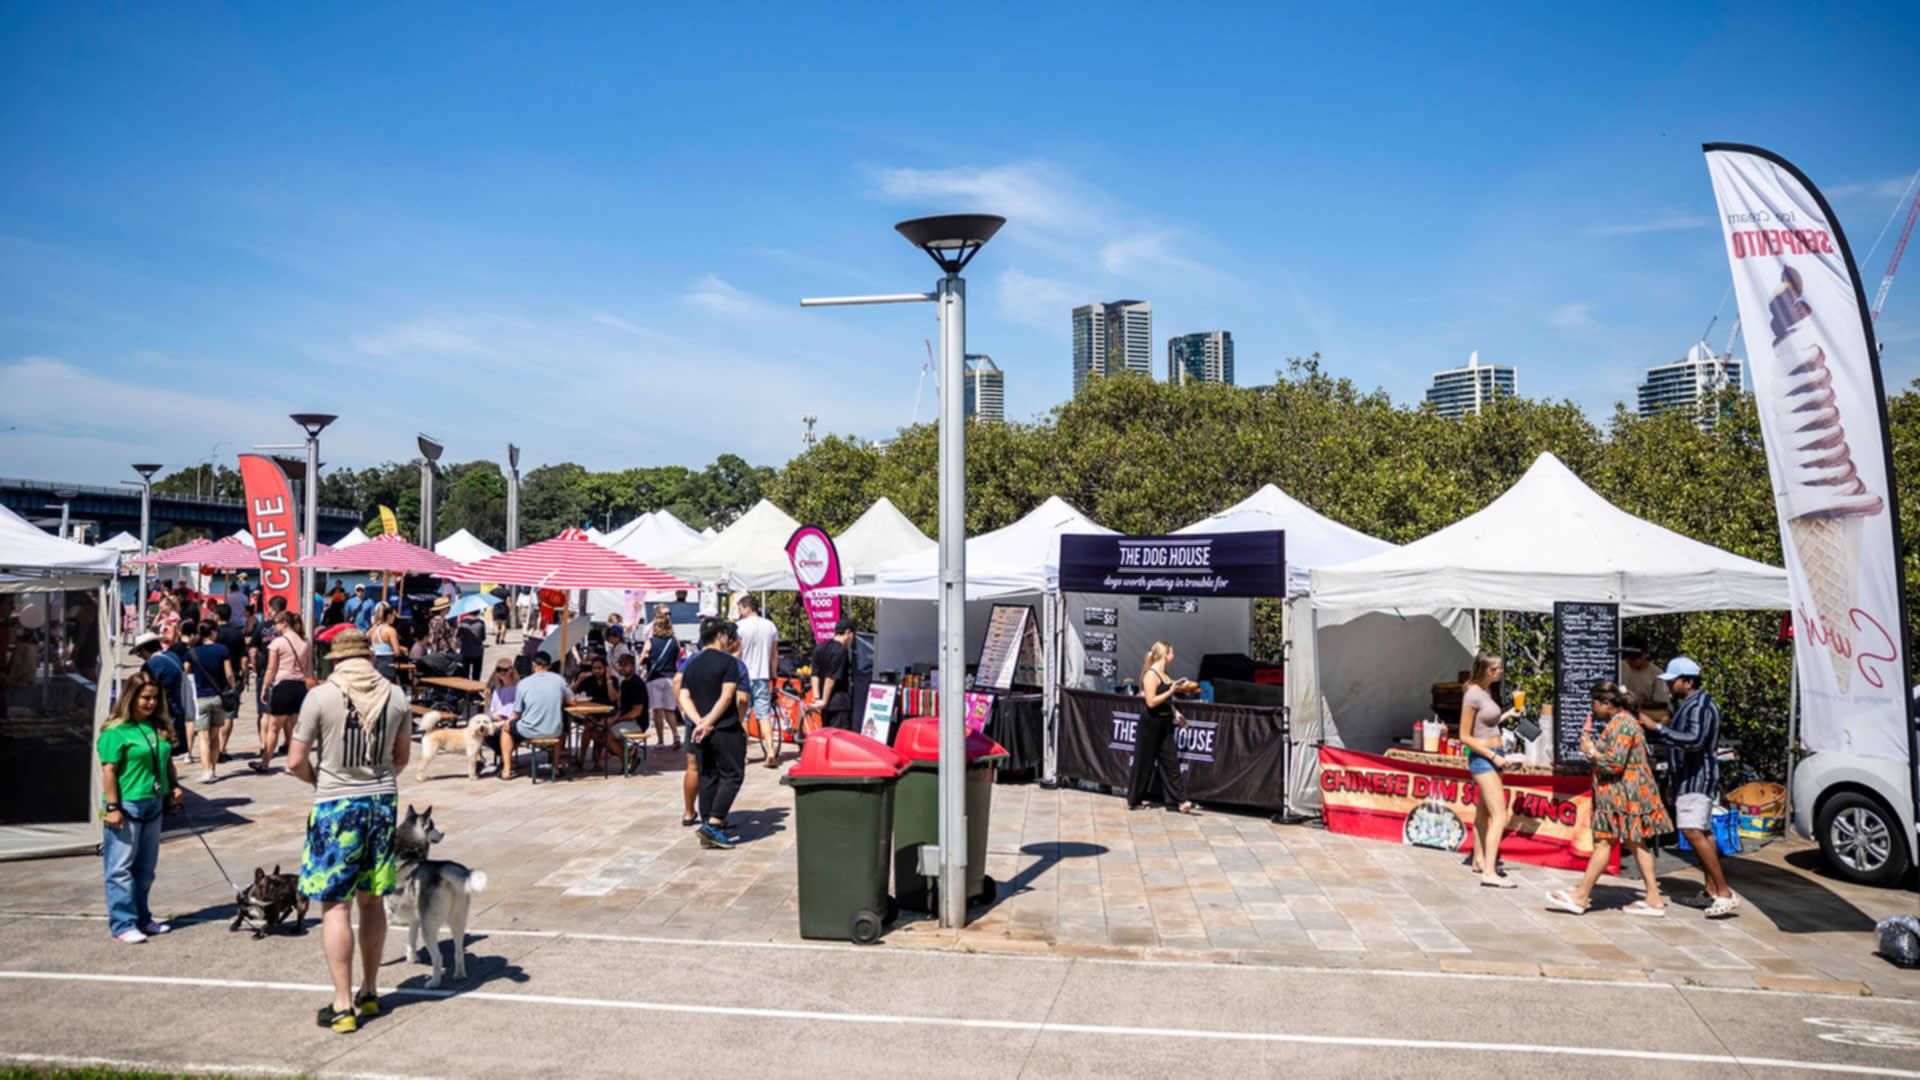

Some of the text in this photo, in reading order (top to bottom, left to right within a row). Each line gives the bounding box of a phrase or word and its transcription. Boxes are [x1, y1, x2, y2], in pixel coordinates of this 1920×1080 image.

[254, 495, 291, 590] CAFE
[1120, 547, 1211, 566] THE DOG HOUSE
[1104, 575, 1229, 592] dogs worth getting in trouble for
[1113, 719, 1138, 742] THE
[1320, 769, 1408, 798] CHINESE
[1412, 777, 1458, 804] DIM
[1513, 791, 1577, 826] KING
